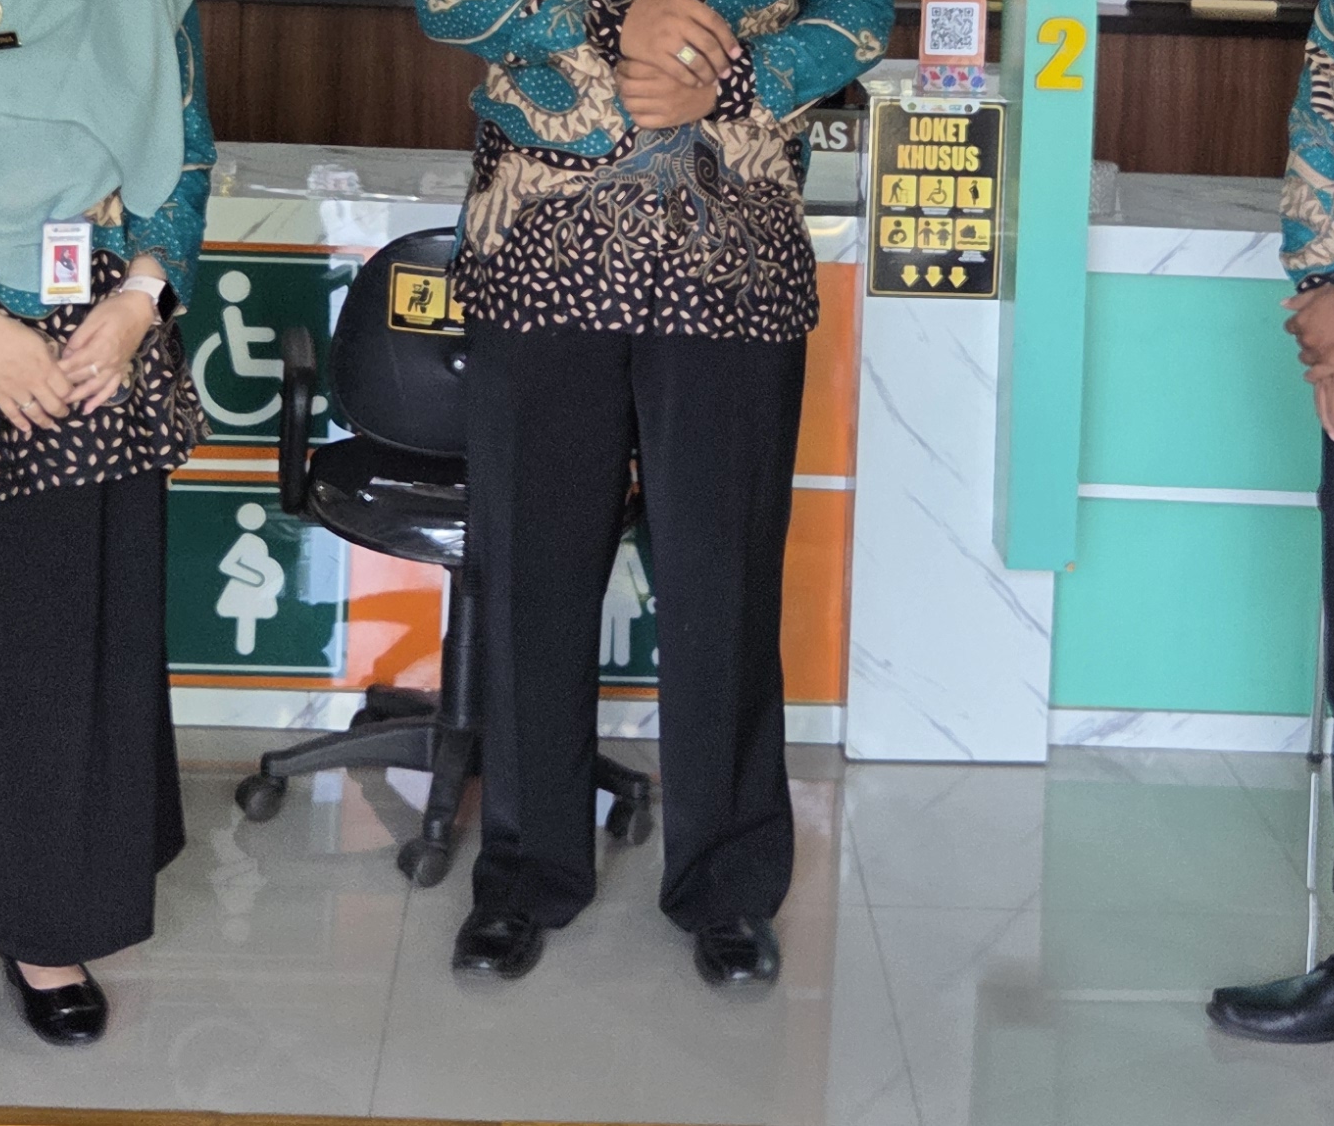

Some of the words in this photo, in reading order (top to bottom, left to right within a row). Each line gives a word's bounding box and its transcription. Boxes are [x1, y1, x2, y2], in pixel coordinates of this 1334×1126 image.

[1035, 17, 1087, 92] 2
[909, 116, 970, 143] LOKET
[897, 145, 980, 172] KHUSUS
